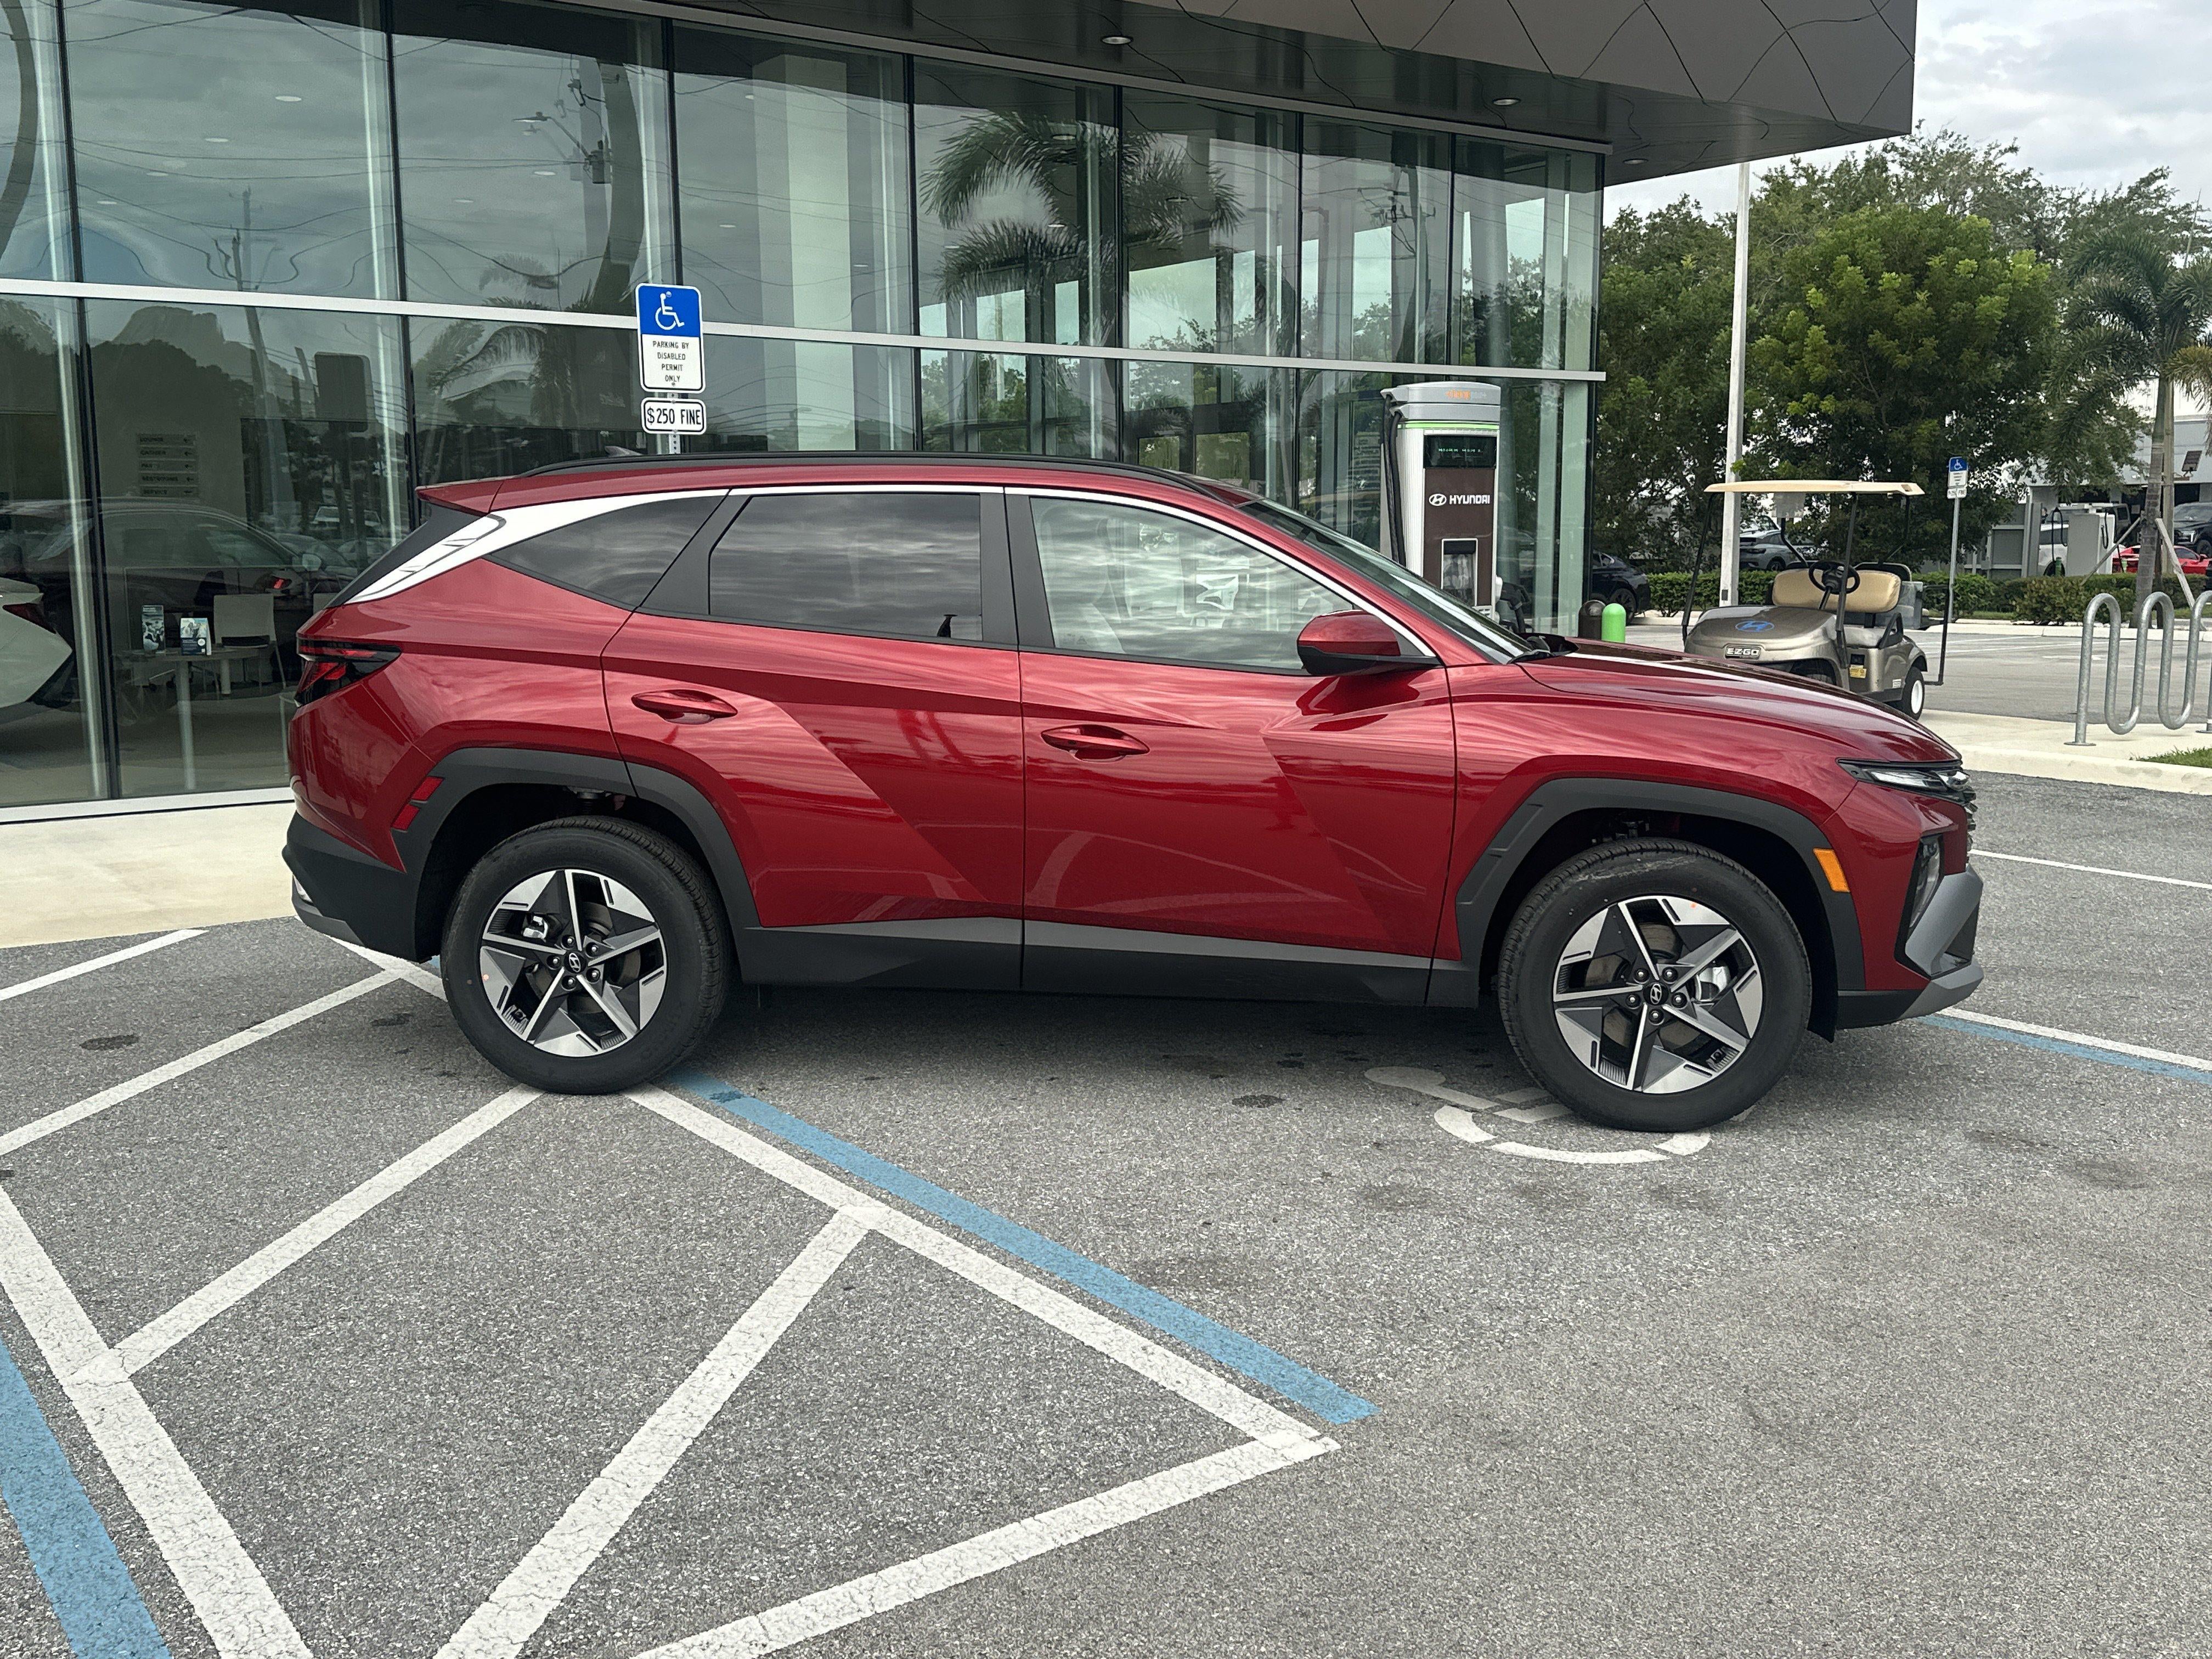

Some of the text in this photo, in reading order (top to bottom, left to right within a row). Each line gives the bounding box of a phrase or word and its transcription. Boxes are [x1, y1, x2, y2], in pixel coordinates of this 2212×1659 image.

[657, 352, 686, 360] DISABLED
[647, 407, 701, 425] $250 FINE
[1449, 495, 1491, 505] HYUNDAI
